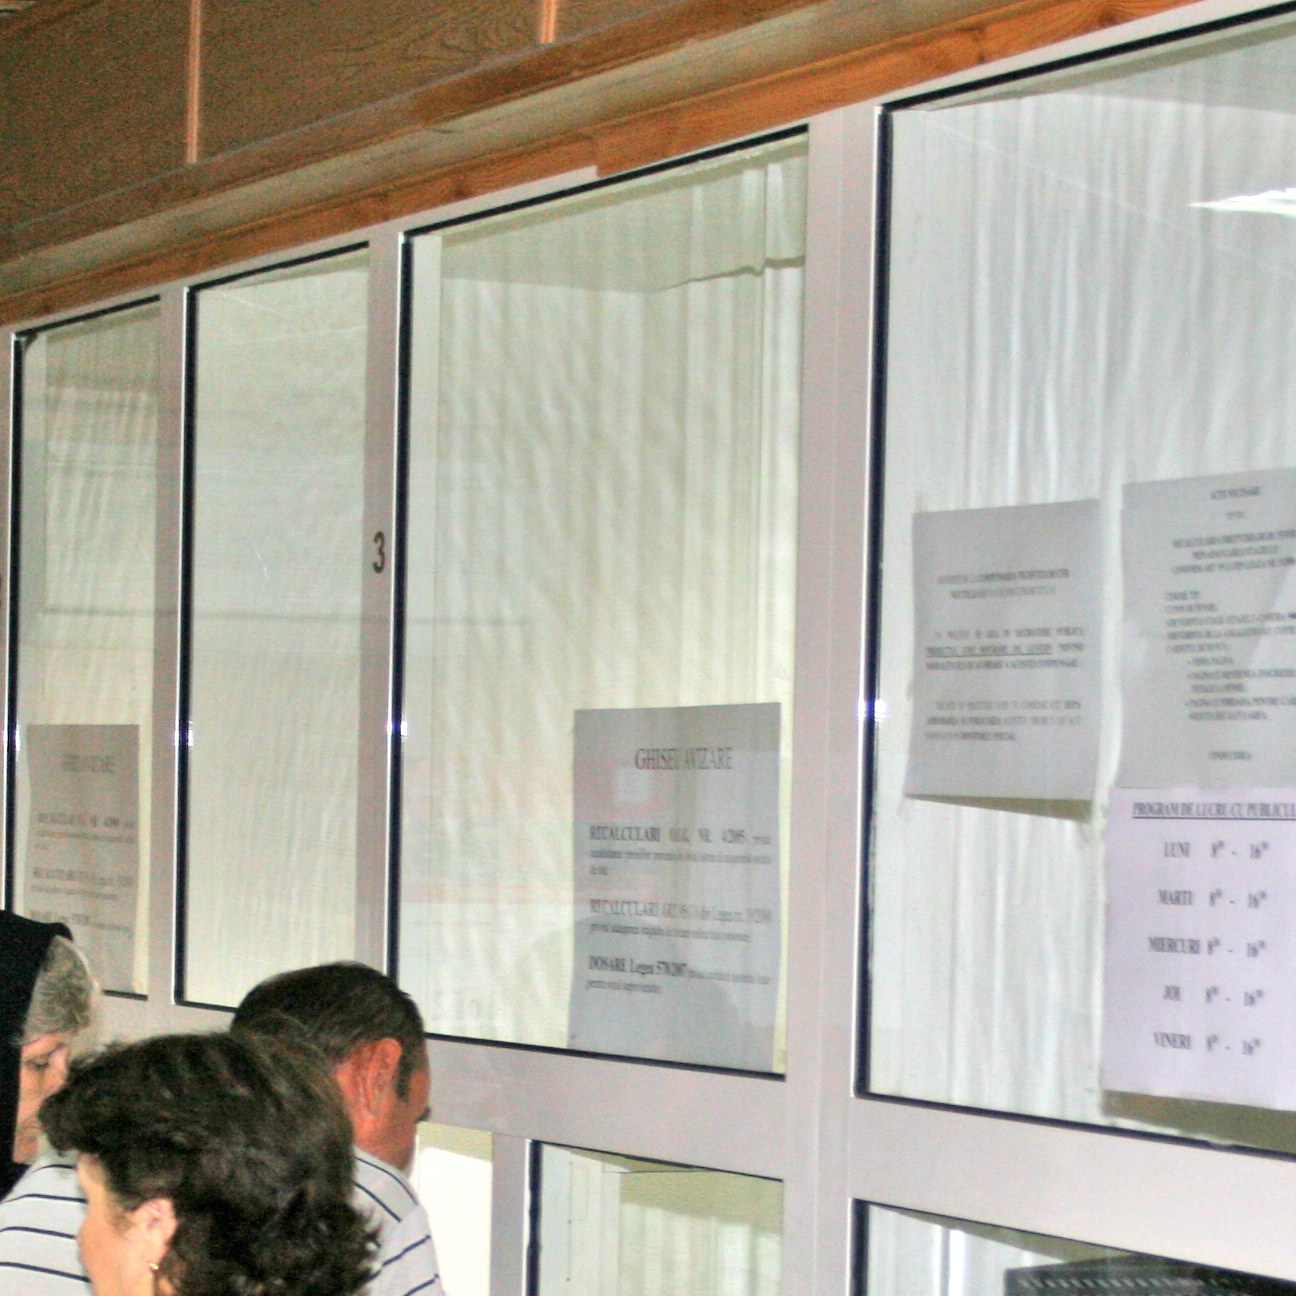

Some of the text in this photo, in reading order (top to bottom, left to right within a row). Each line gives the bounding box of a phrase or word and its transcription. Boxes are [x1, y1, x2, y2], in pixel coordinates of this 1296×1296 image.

[373, 531, 385, 574] 3
[634, 747, 733, 770] GHISEU AVIZARE
[1132, 802, 1179, 817] PROGRAM
[1180, 802, 1193, 817] DE
[1230, 803, 1242, 818] CU
[1247, 802, 1296, 818] PUBLICUL
[590, 824, 661, 843] RECALCULARI
[1164, 842, 1190, 858] LUNI
[1148, 936, 1200, 955] MIERCURI
[589, 954, 627, 973] DOSARE
[629, 958, 655, 976] Legea
[1163, 985, 1180, 1001] JOI
[1153, 1032, 1191, 1050] VINERI
